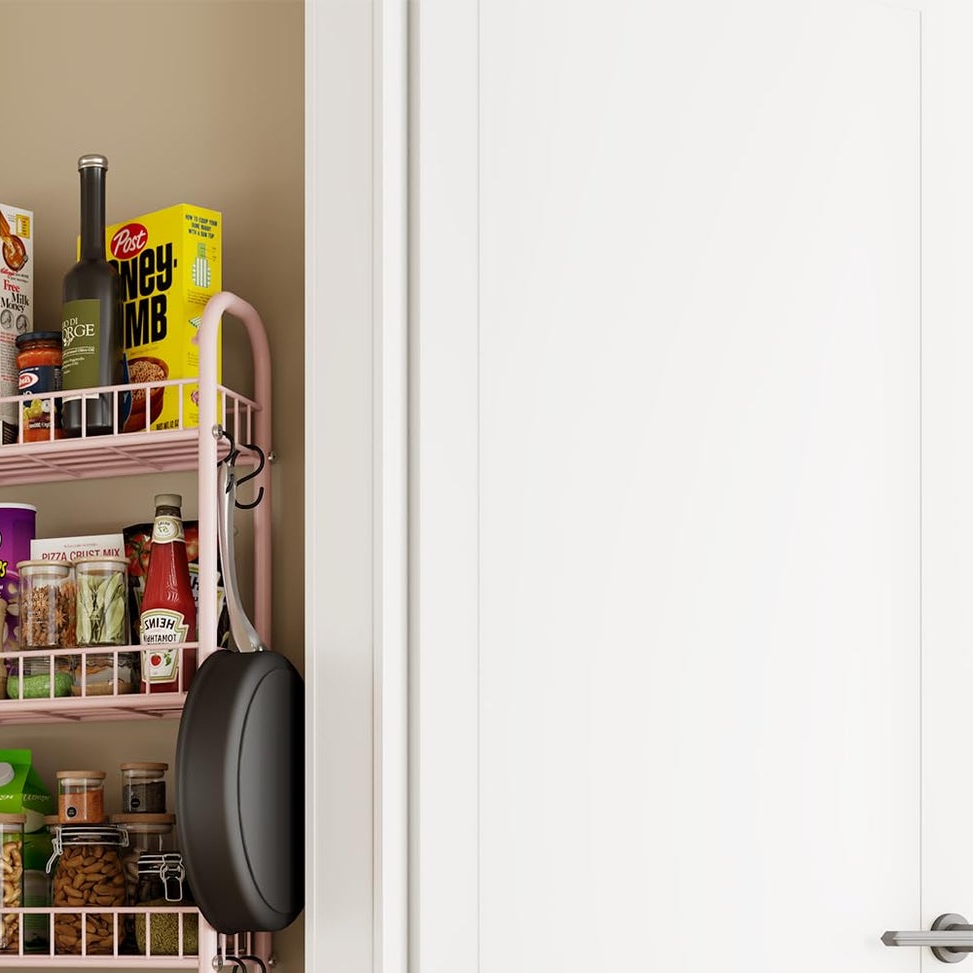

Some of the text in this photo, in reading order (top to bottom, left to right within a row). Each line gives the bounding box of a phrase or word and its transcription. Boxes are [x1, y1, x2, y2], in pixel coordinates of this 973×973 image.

[113, 229, 146, 256] Post
[2, 279, 20, 292] Free
[0, 297, 26, 313] Money
[11, 292, 29, 306] Milk
[42, 548, 120, 561] PIZZA CRUST MIX
